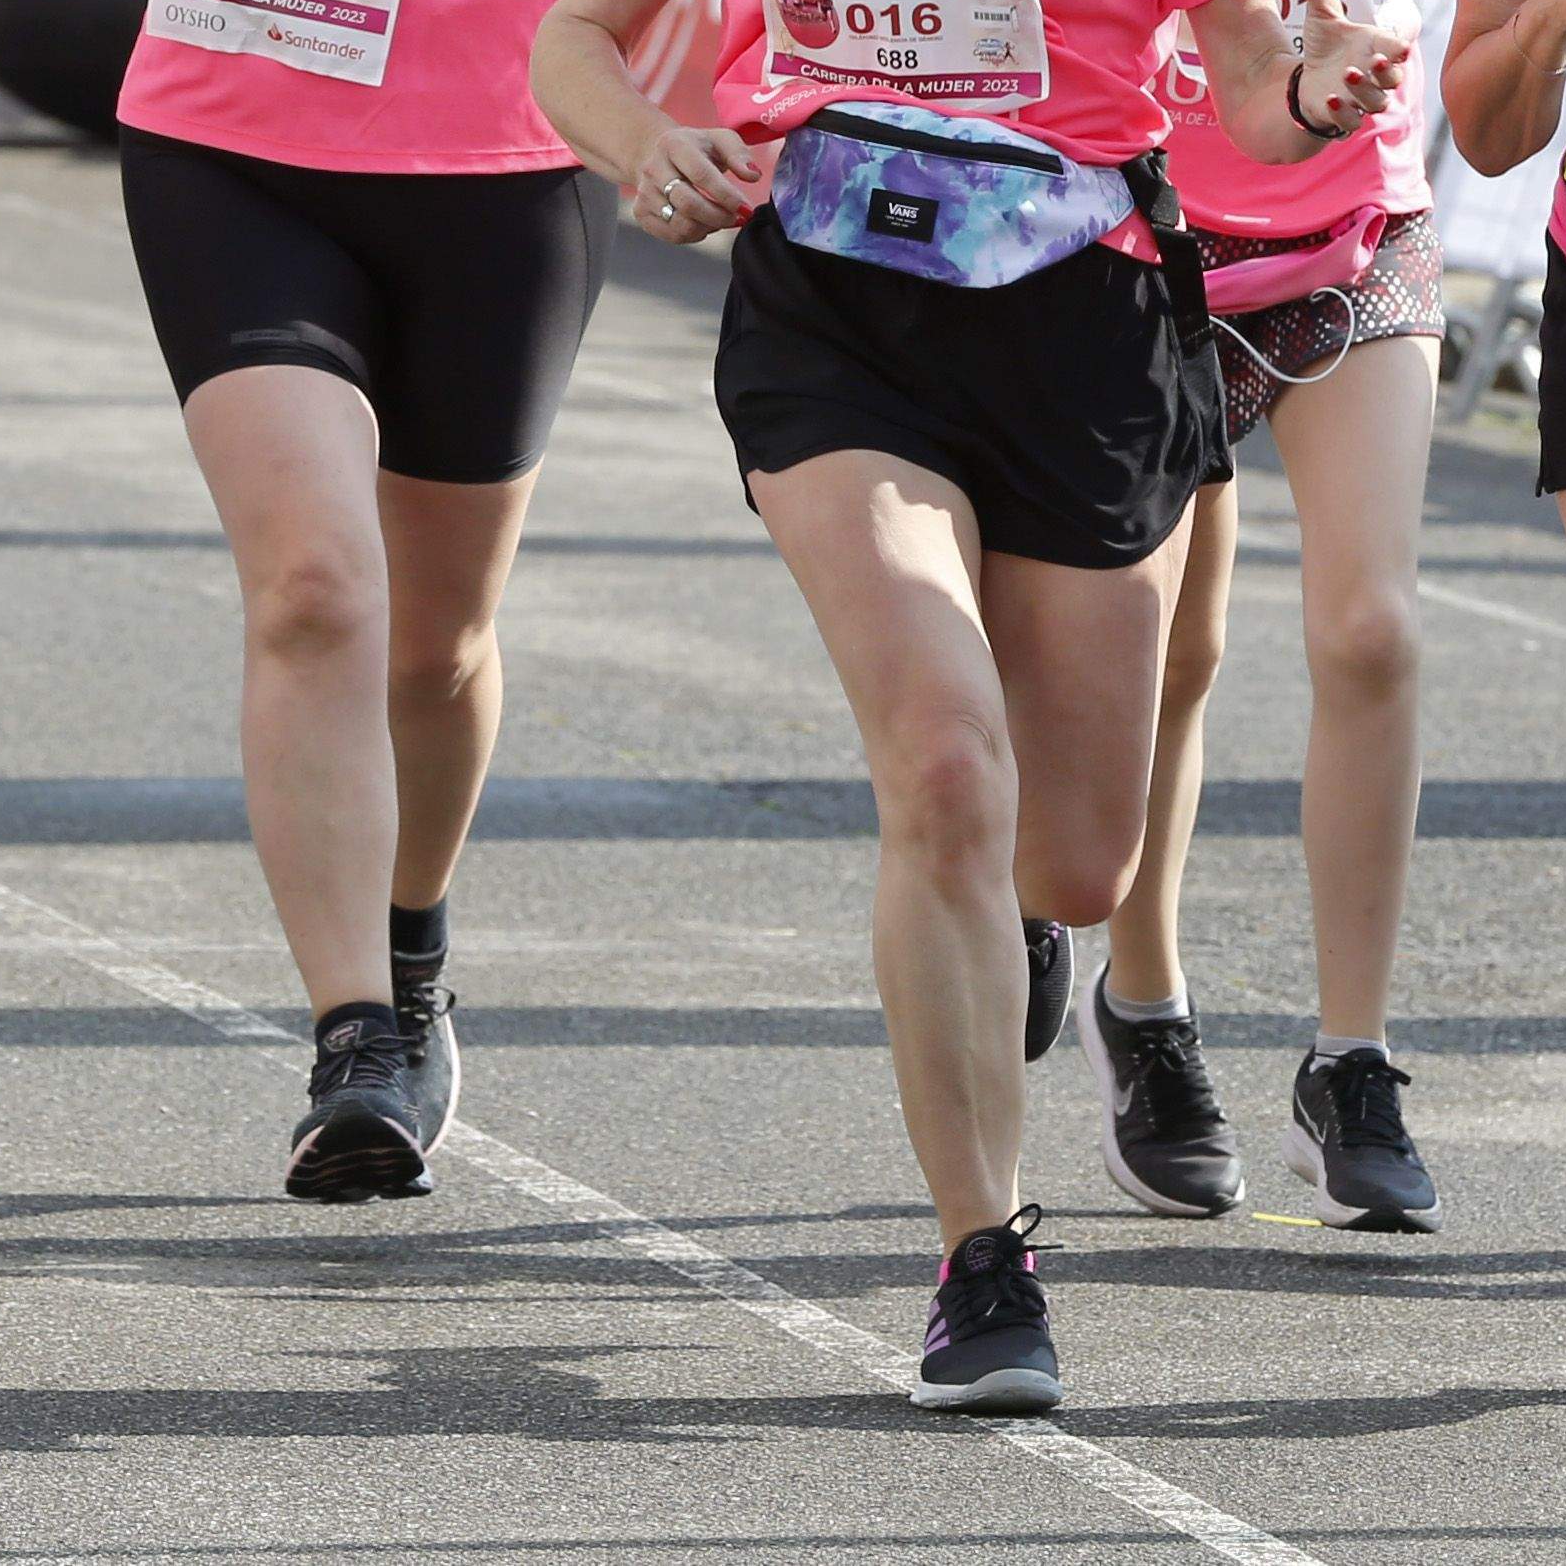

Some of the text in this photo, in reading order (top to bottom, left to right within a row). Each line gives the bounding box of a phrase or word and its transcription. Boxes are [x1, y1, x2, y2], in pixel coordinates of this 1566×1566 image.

[165, 3, 226, 33] OYSHO
[330, 6, 367, 24] 2023
[846, 2, 943, 35] 016
[284, 30, 366, 61] Santander
[877, 47, 918, 69] 688
[800, 63, 867, 86] CARRERA
[919, 80, 974, 93] MUJER
[982, 79, 1019, 92] 2023
[888, 202, 919, 219] VANS
